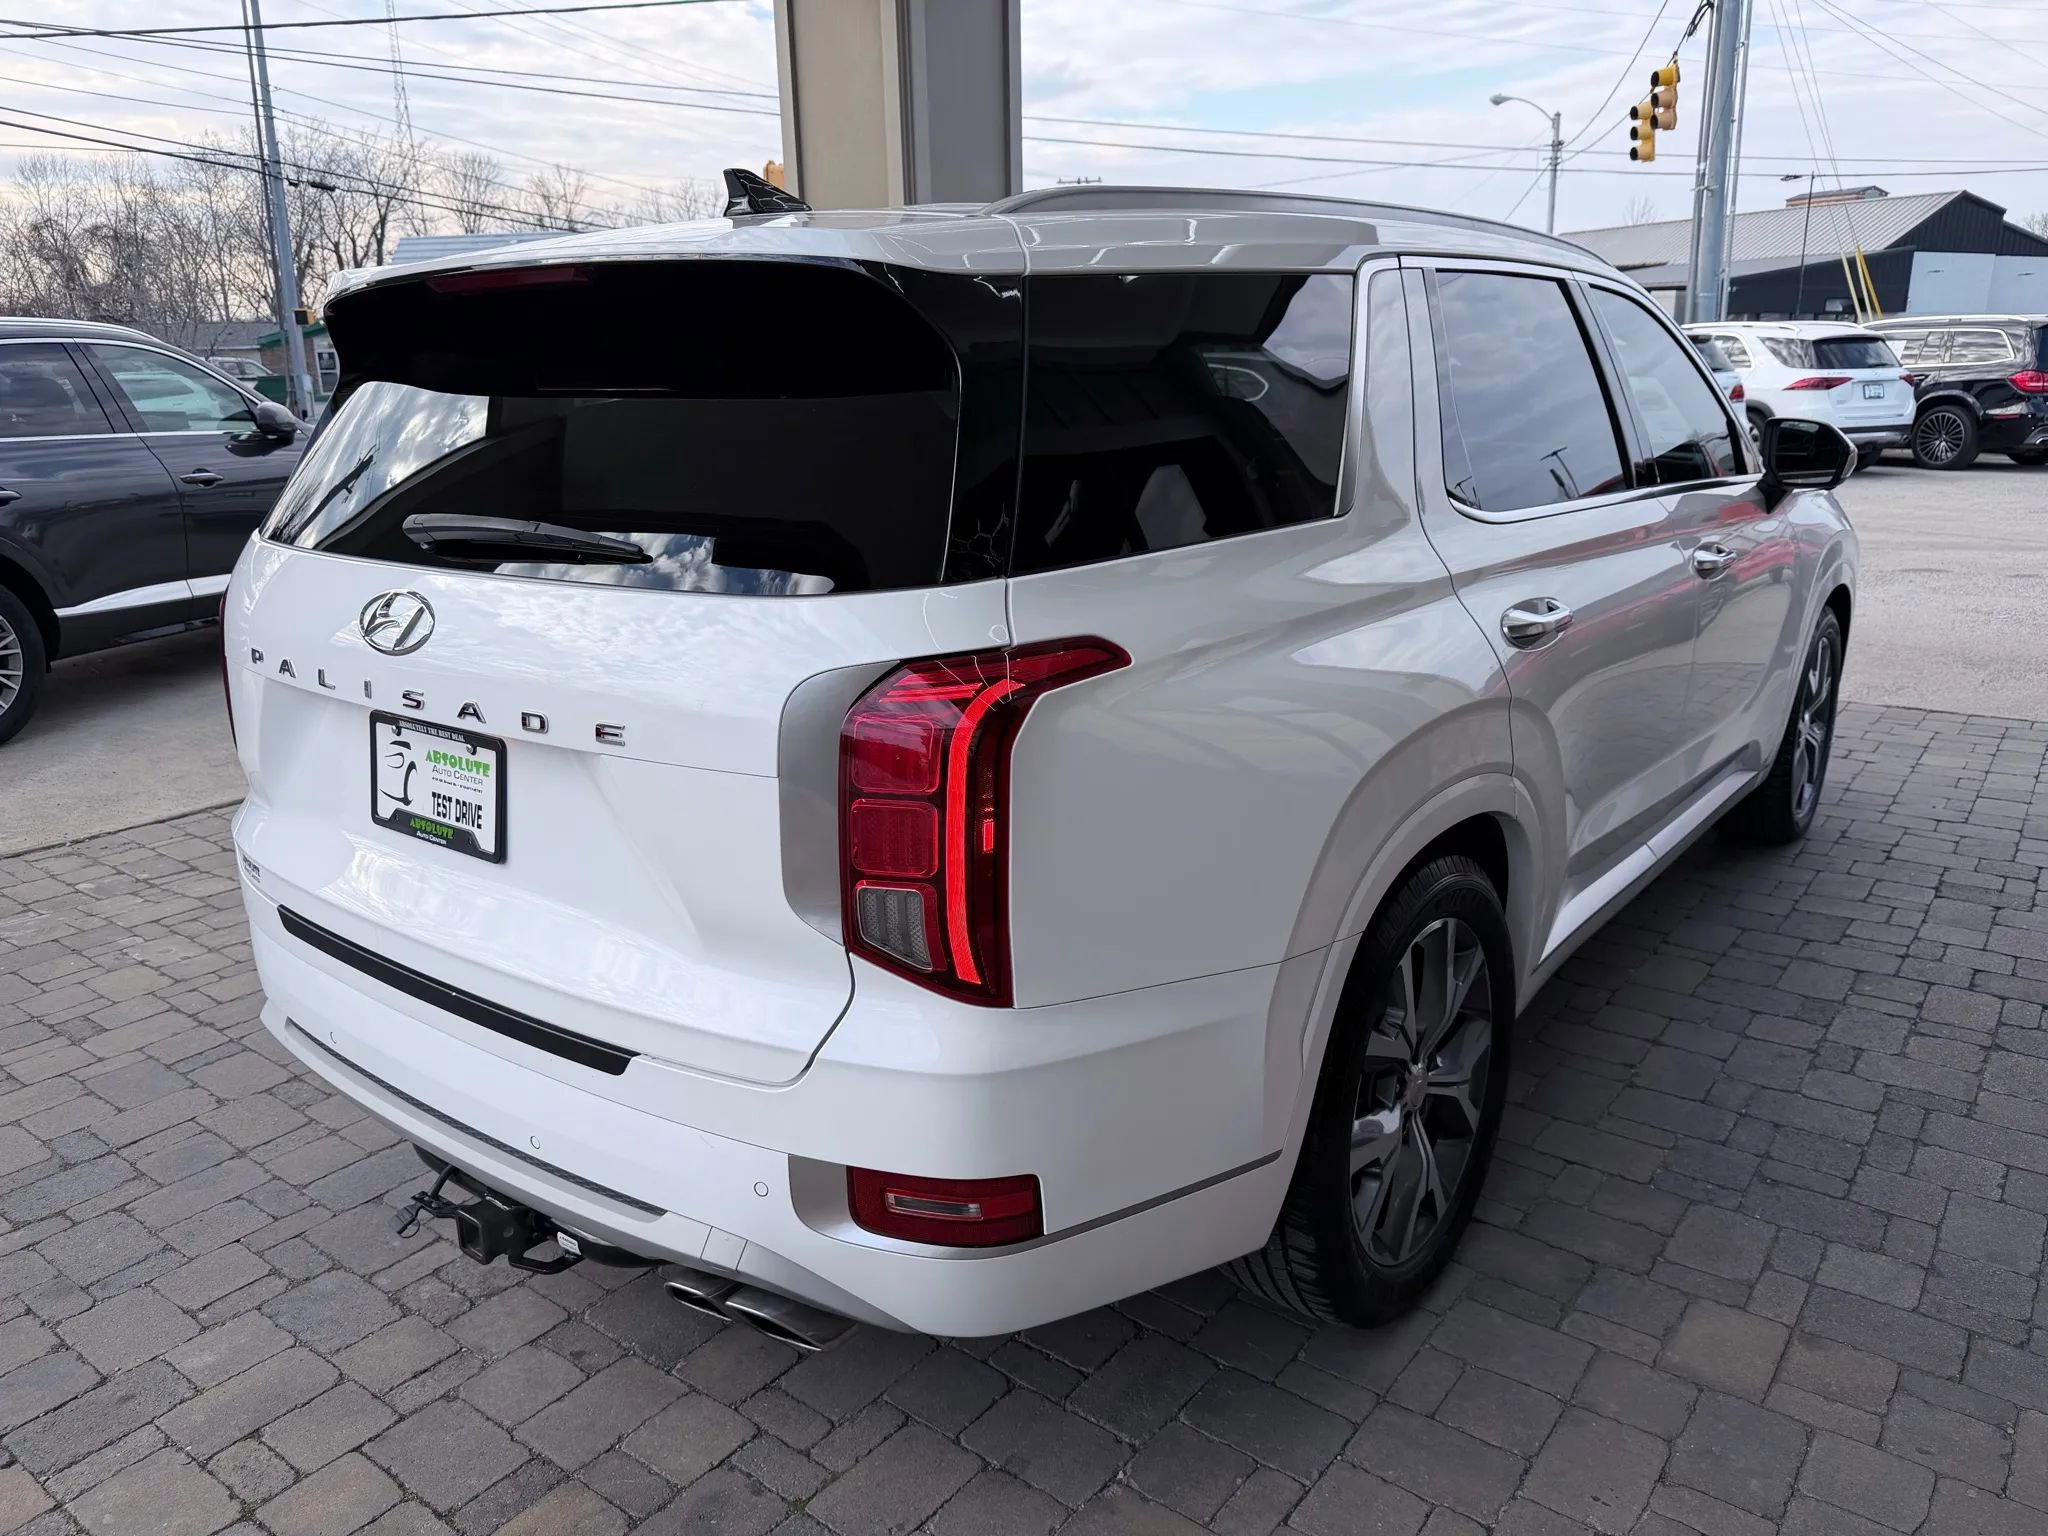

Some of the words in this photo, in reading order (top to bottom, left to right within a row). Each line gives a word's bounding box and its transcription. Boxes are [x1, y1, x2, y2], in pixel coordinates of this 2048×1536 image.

[250, 647, 627, 747] PALISADE
[399, 720, 427, 733] ABSOLUTELY
[427, 727, 438, 736] THE
[438, 730, 451, 739] BEST
[451, 732, 466, 742] DEAL
[425, 749, 491, 777] ABSOLUTE
[432, 791, 452, 821] TEST
[455, 798, 483, 829] DRIVE
[410, 817, 454, 840] ABSOLUTE
